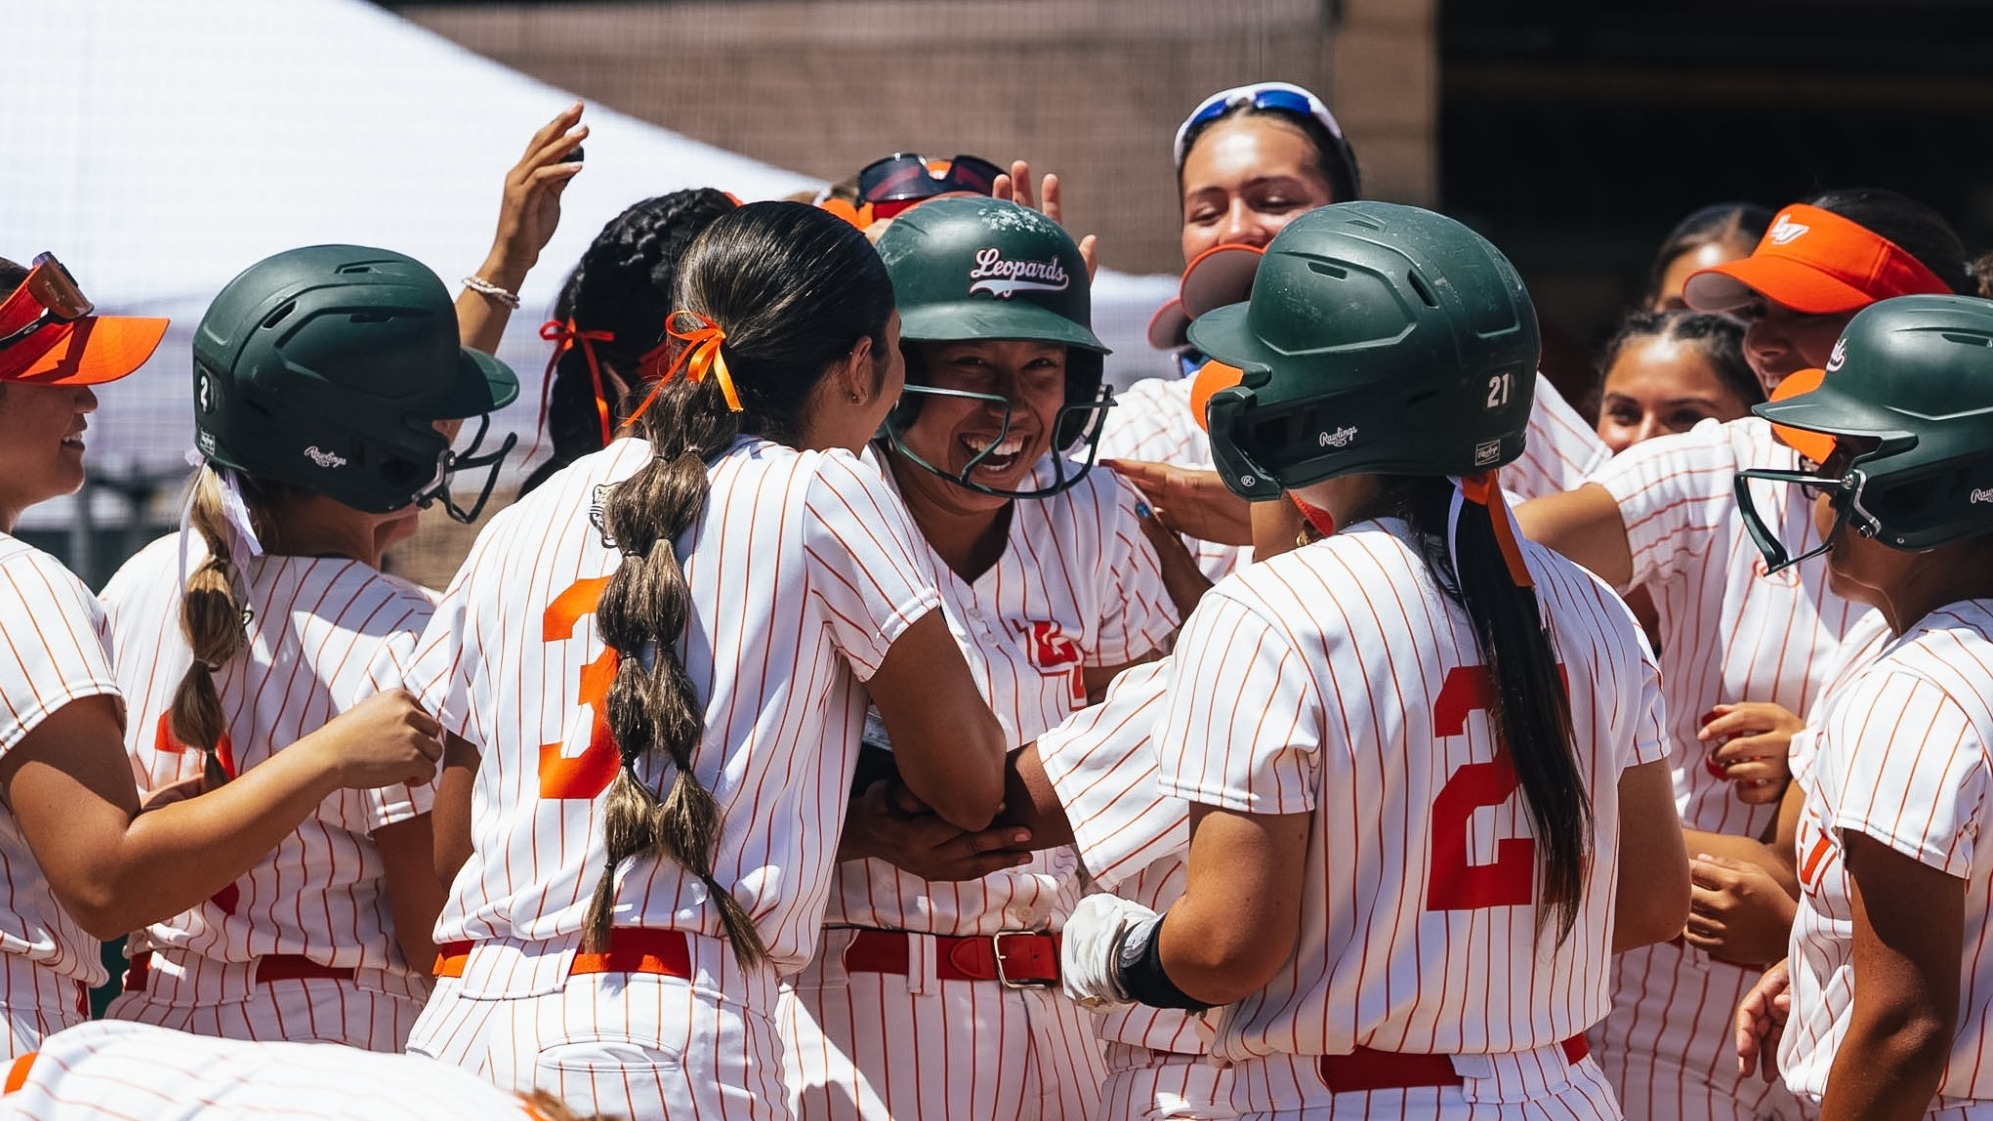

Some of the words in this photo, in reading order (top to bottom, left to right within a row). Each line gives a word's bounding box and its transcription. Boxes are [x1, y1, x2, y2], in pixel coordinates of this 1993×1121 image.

[969, 248, 1069, 297] Leopards
[1486, 372, 1510, 408] 21
[1319, 426, 1358, 447] Rawlings
[1426, 663, 1588, 912] 2
